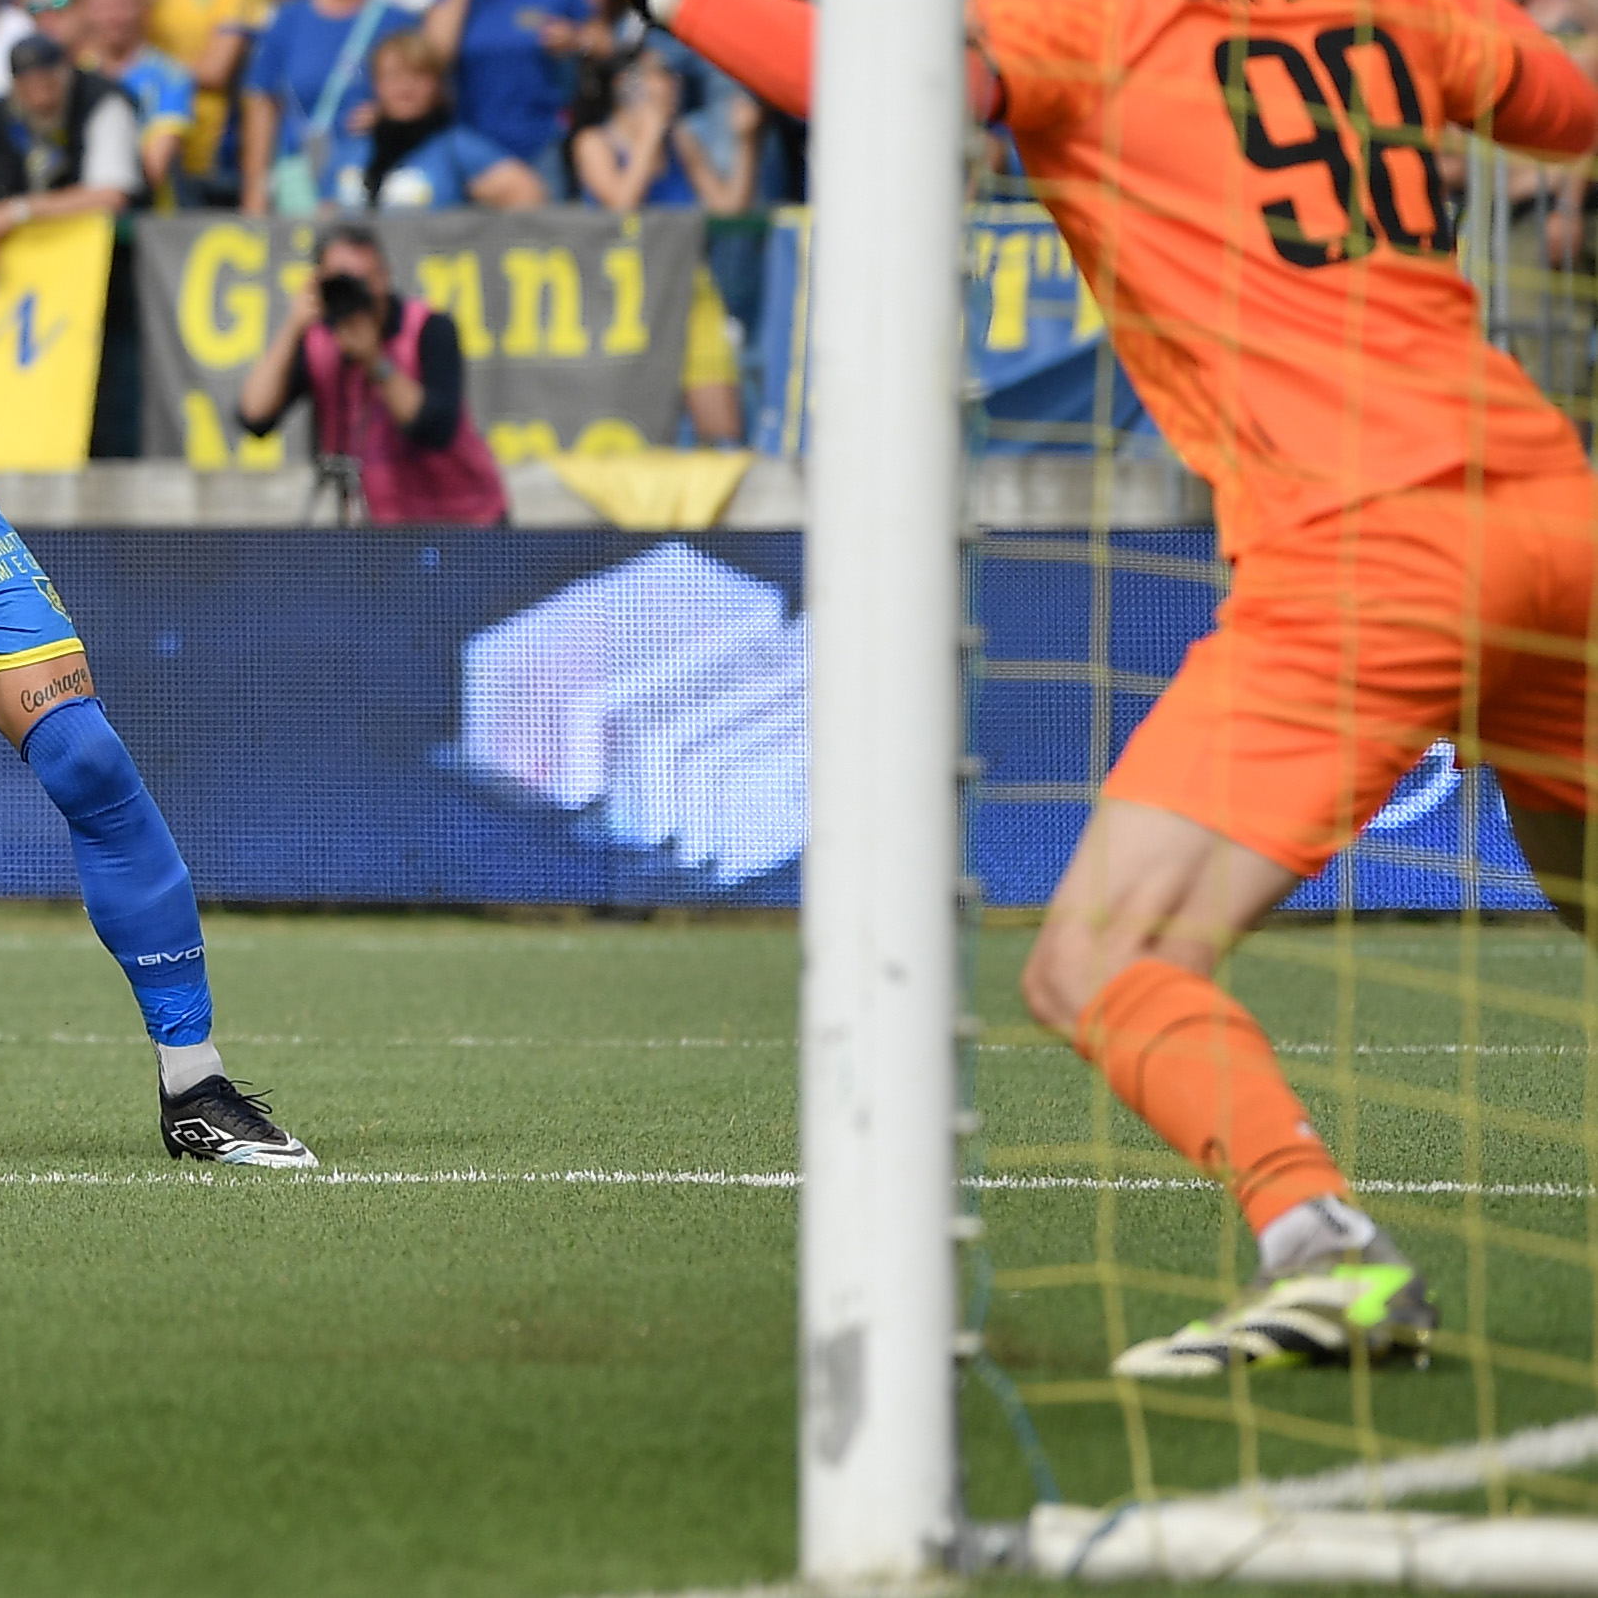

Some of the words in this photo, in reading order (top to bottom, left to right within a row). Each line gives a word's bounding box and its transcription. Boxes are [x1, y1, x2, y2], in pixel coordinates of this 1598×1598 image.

[1215, 25, 1455, 269] 98
[177, 214, 650, 370] Ginni
[21, 667, 89, 713] Courage
